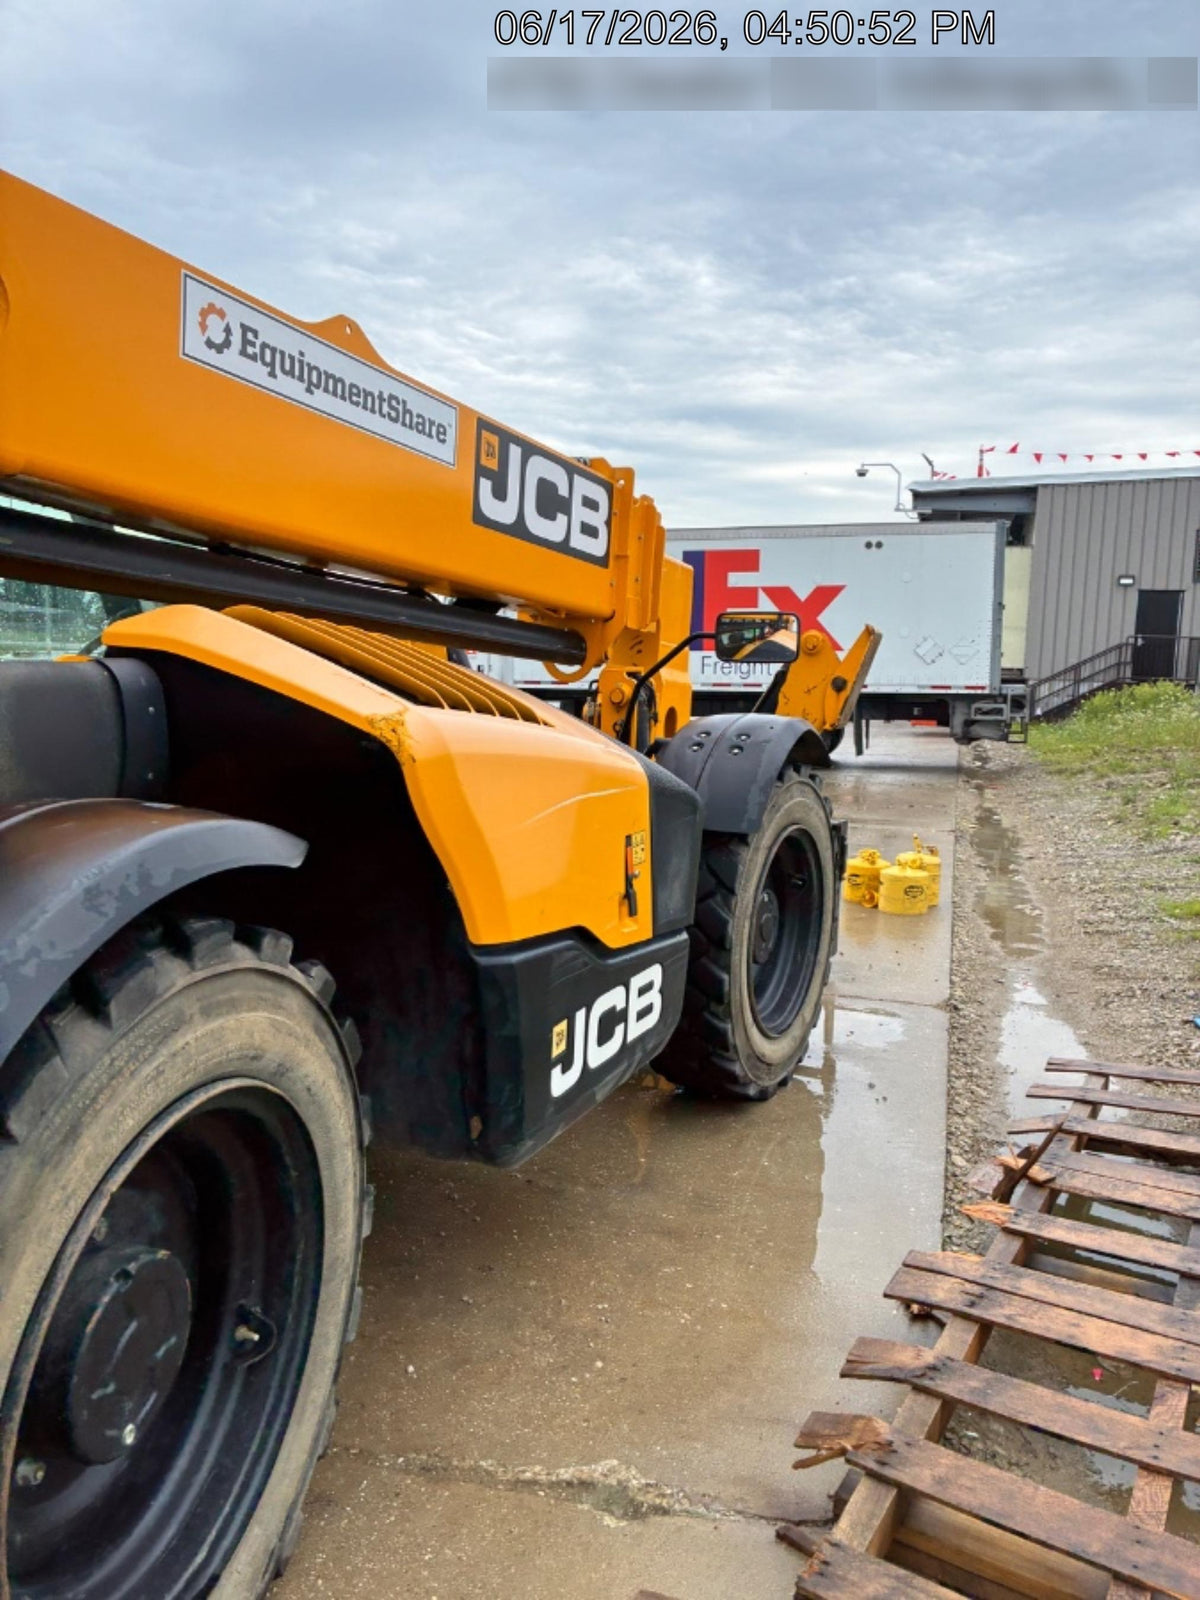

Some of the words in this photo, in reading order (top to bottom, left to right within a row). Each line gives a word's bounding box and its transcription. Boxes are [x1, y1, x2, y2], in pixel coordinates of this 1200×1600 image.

[238, 321, 448, 445] EquipmentShare
[479, 441, 609, 557] JCB
[550, 963, 662, 1098] JCB
